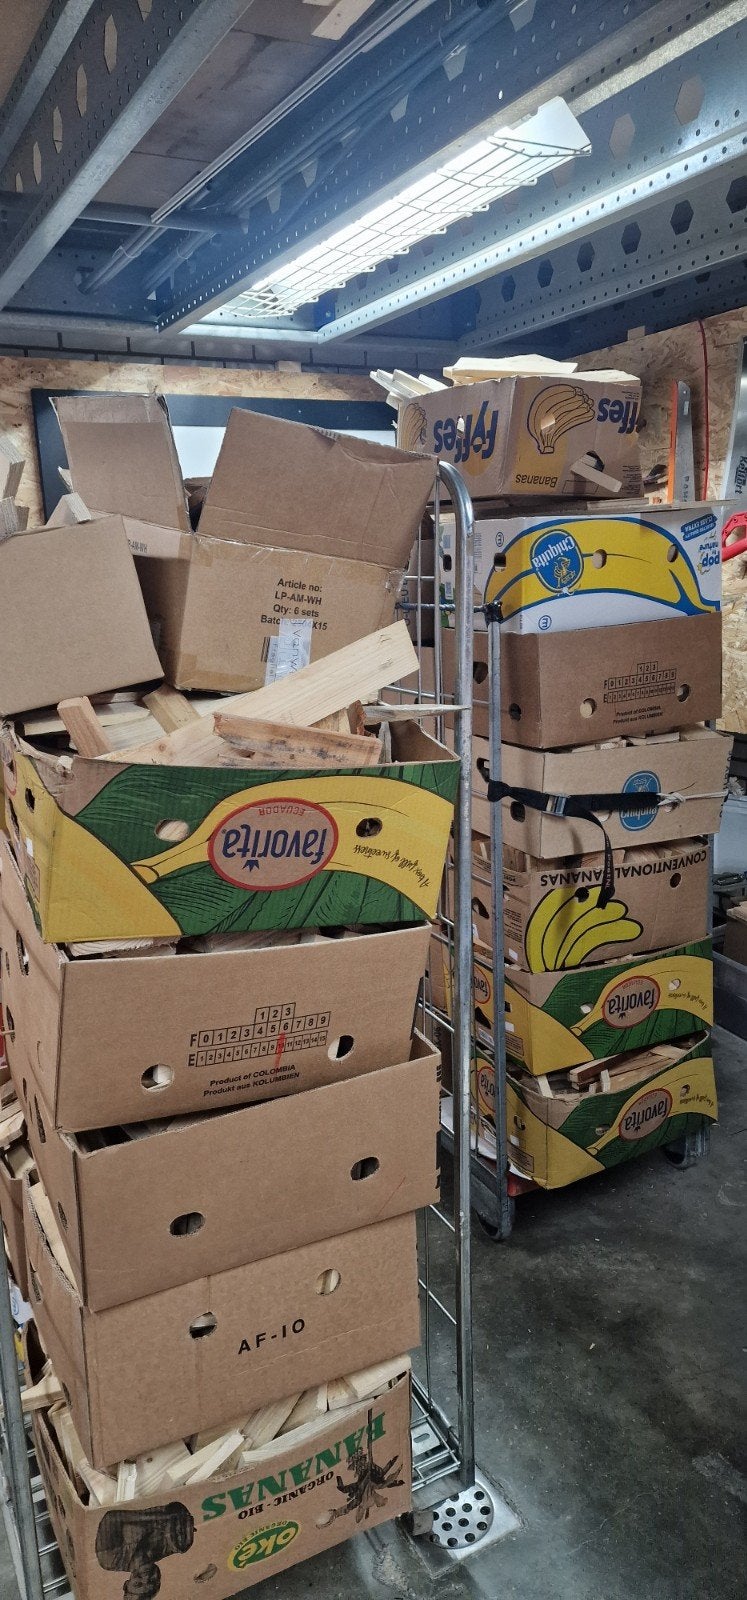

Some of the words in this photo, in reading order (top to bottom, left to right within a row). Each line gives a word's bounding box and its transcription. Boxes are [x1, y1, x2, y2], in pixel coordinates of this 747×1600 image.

[515, 474, 558, 488] Bananas
[531, 536, 576, 568] Chiquita
[702, 551, 720, 567] pop
[277, 578, 306, 590] Article
[274, 591, 322, 605] LP-AM-WH
[273, 604, 292, 615] Qty:
[294, 607, 299, 615] 6
[301, 609, 320, 617] sets
[260, 615, 282, 625] Batc
[258, 805, 306, 816] ECUADOR
[222, 824, 327, 865] favorita
[399, 858, 418, 872] full
[616, 850, 707, 878] CONVENTIONAL
[419, 878, 431, 888] A
[540, 868, 604, 887] ANANAS
[608, 988, 656, 1015] favorita
[260, 1010, 265, 1020] 1
[272, 1010, 278, 1018] 2
[285, 1007, 291, 1016] 3
[190, 1034, 197, 1047] F
[203, 1034, 209, 1043] 0
[218, 1032, 223, 1041] 1
[231, 1030, 237, 1039] 2
[244, 1029, 250, 1038] 3
[257, 1026, 263, 1035] 4
[270, 1024, 276, 1033] 5
[283, 1022, 289, 1031] 6
[296, 1020, 301, 1028] 7
[308, 1018, 314, 1027] 8
[320, 1016, 326, 1024] 9
[210, 1076, 241, 1086] Product
[252, 1064, 296, 1078] COLOMBIA
[203, 1086, 234, 1097] Produkt
[252, 1072, 300, 1087] KOLUMBIEN
[624, 1098, 668, 1131] favorita
[273, 1471, 334, 1507] ORGANIC
[238, 1505, 264, 1520] BIO
[238, 1527, 297, 1568] oké
